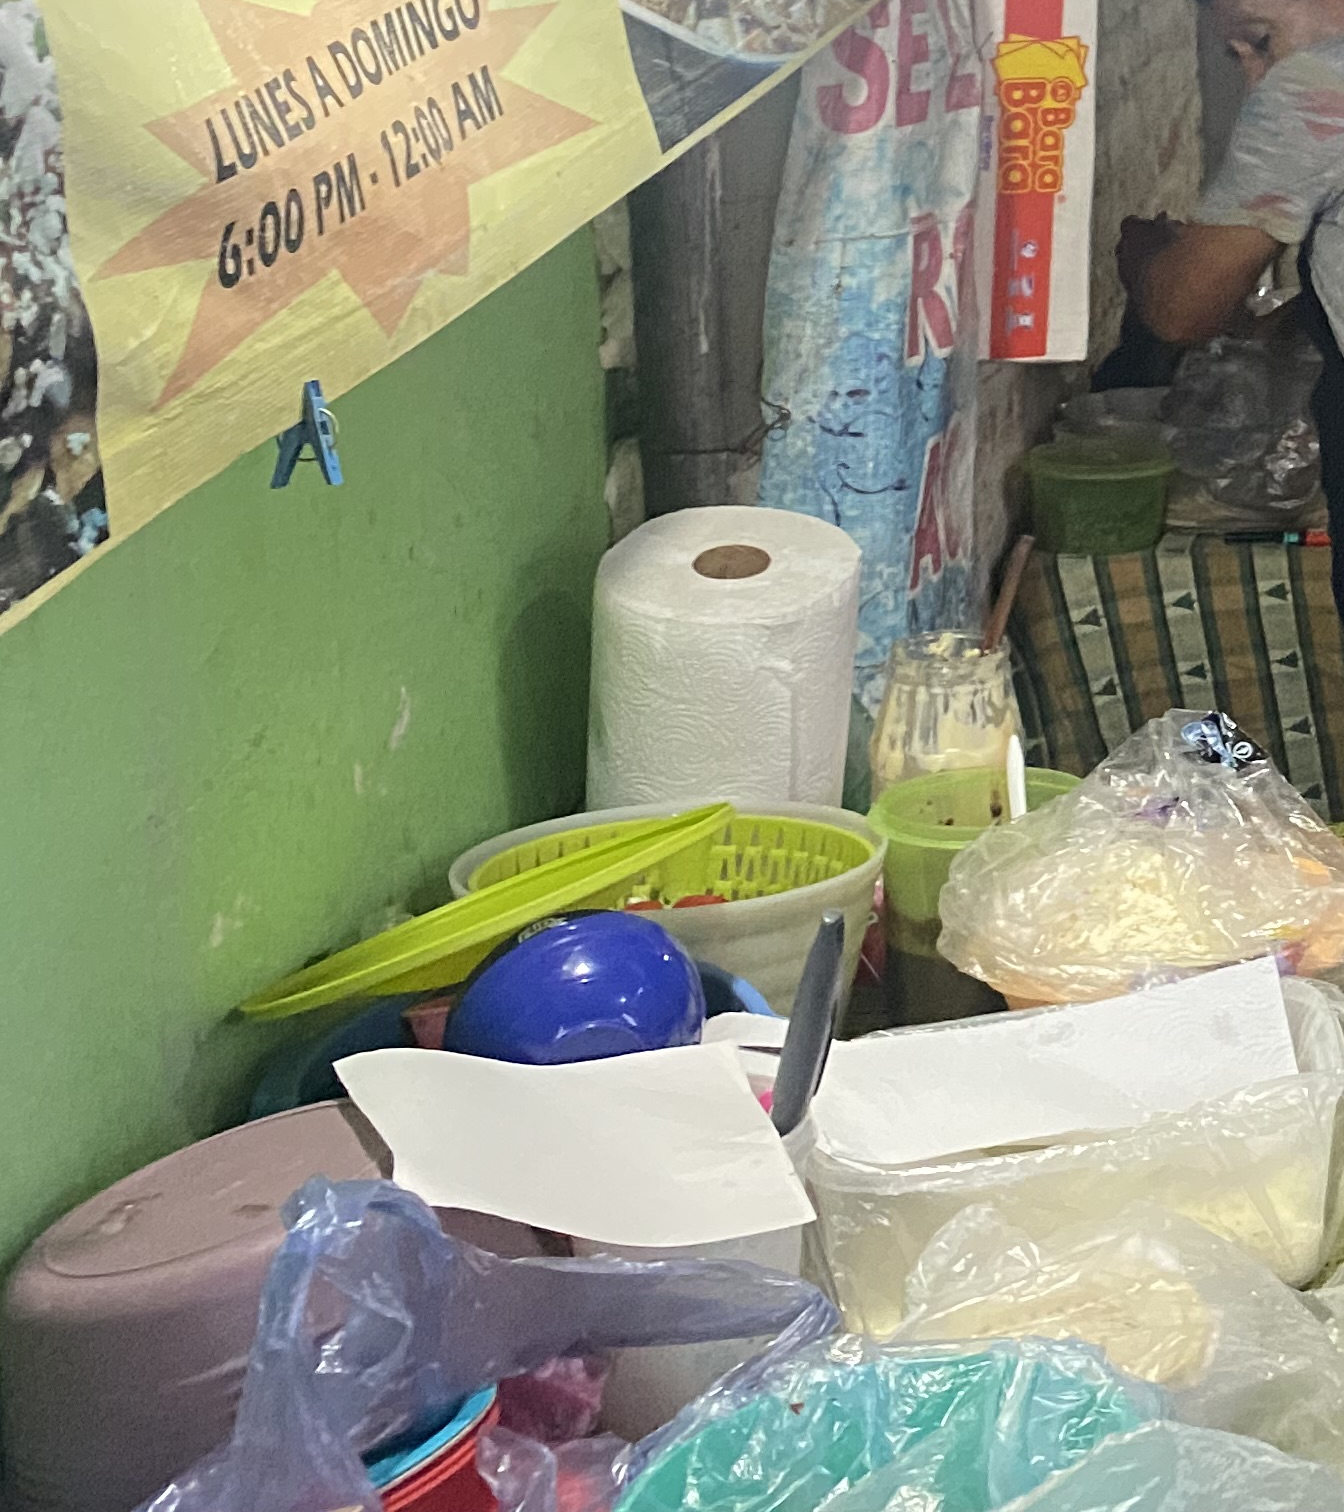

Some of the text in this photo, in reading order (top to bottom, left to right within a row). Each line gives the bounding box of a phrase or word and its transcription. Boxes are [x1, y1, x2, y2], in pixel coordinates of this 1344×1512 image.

[204, 68, 317, 185] LUNES
[306, 55, 345, 118] A
[217, 188, 305, 289] 6:00
[312, 153, 367, 237] PM
[379, 96, 454, 188] 12:00
[451, 65, 505, 141] AM
[999, 78, 1048, 193] Bara
[1036, 104, 1075, 193] Bara
